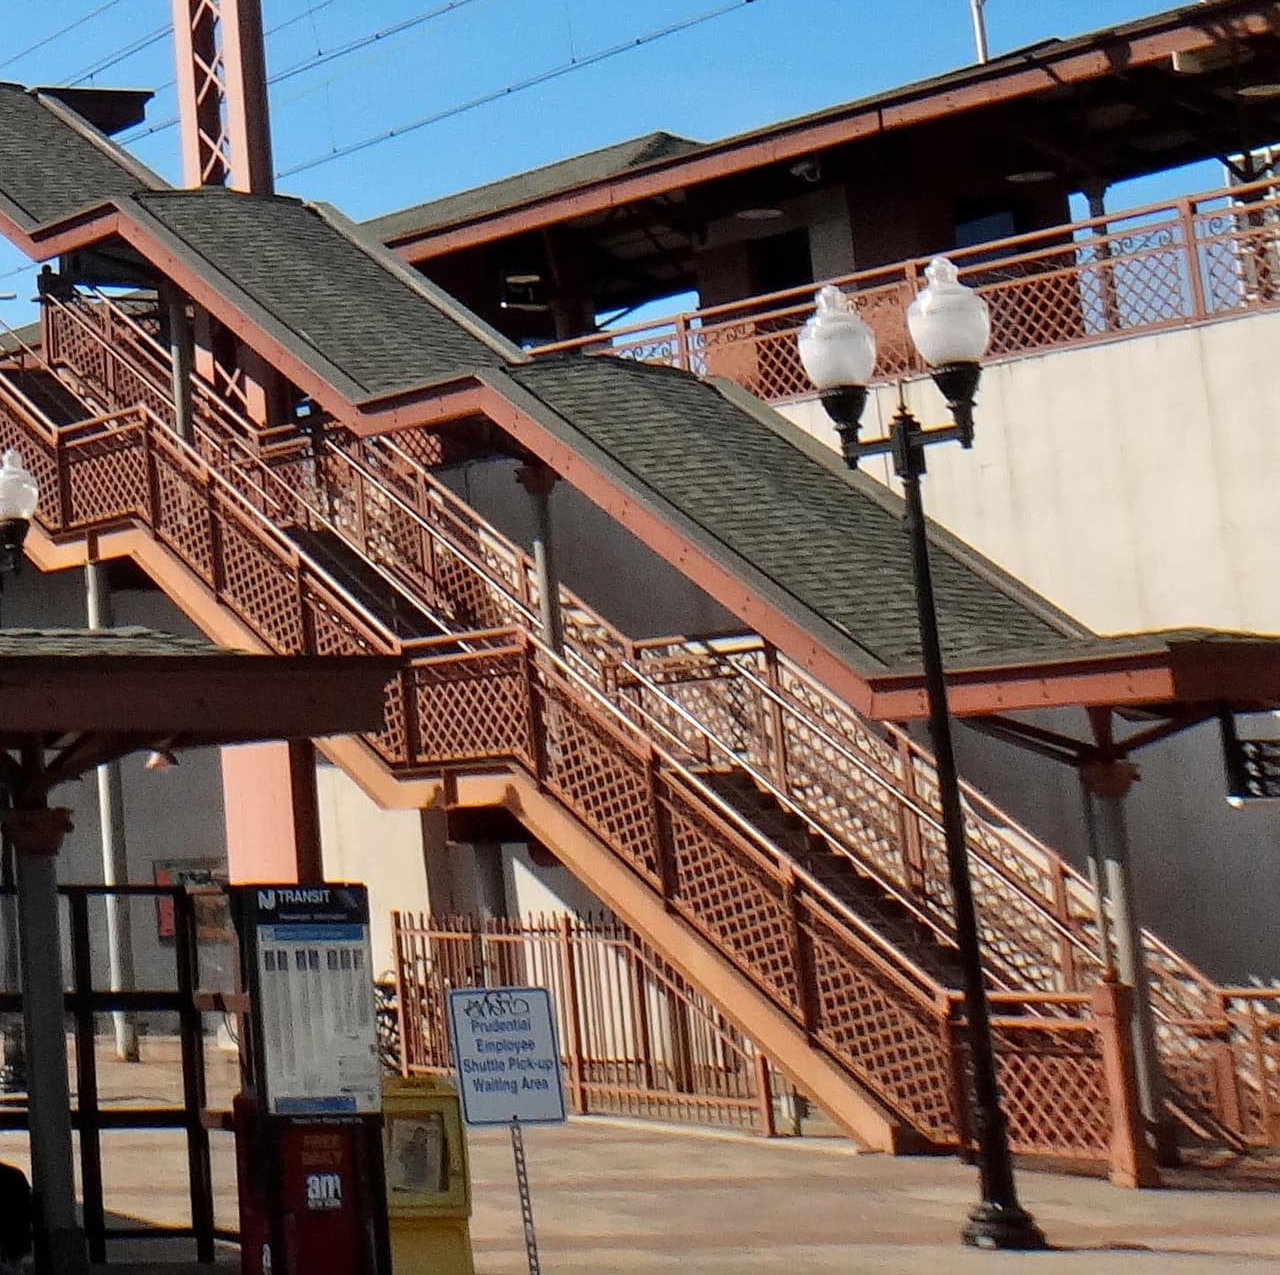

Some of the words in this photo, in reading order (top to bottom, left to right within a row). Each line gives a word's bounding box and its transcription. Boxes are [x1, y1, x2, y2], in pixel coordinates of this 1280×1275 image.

[277, 889, 331, 903] TRANSIT
[471, 1018, 532, 1033] Prudential
[475, 1038, 536, 1054] Employee
[463, 1058, 506, 1074] Shuttle
[508, 1056, 554, 1072] Pick-up
[472, 1077, 518, 1095] Waiting
[522, 1076, 549, 1091] Area
